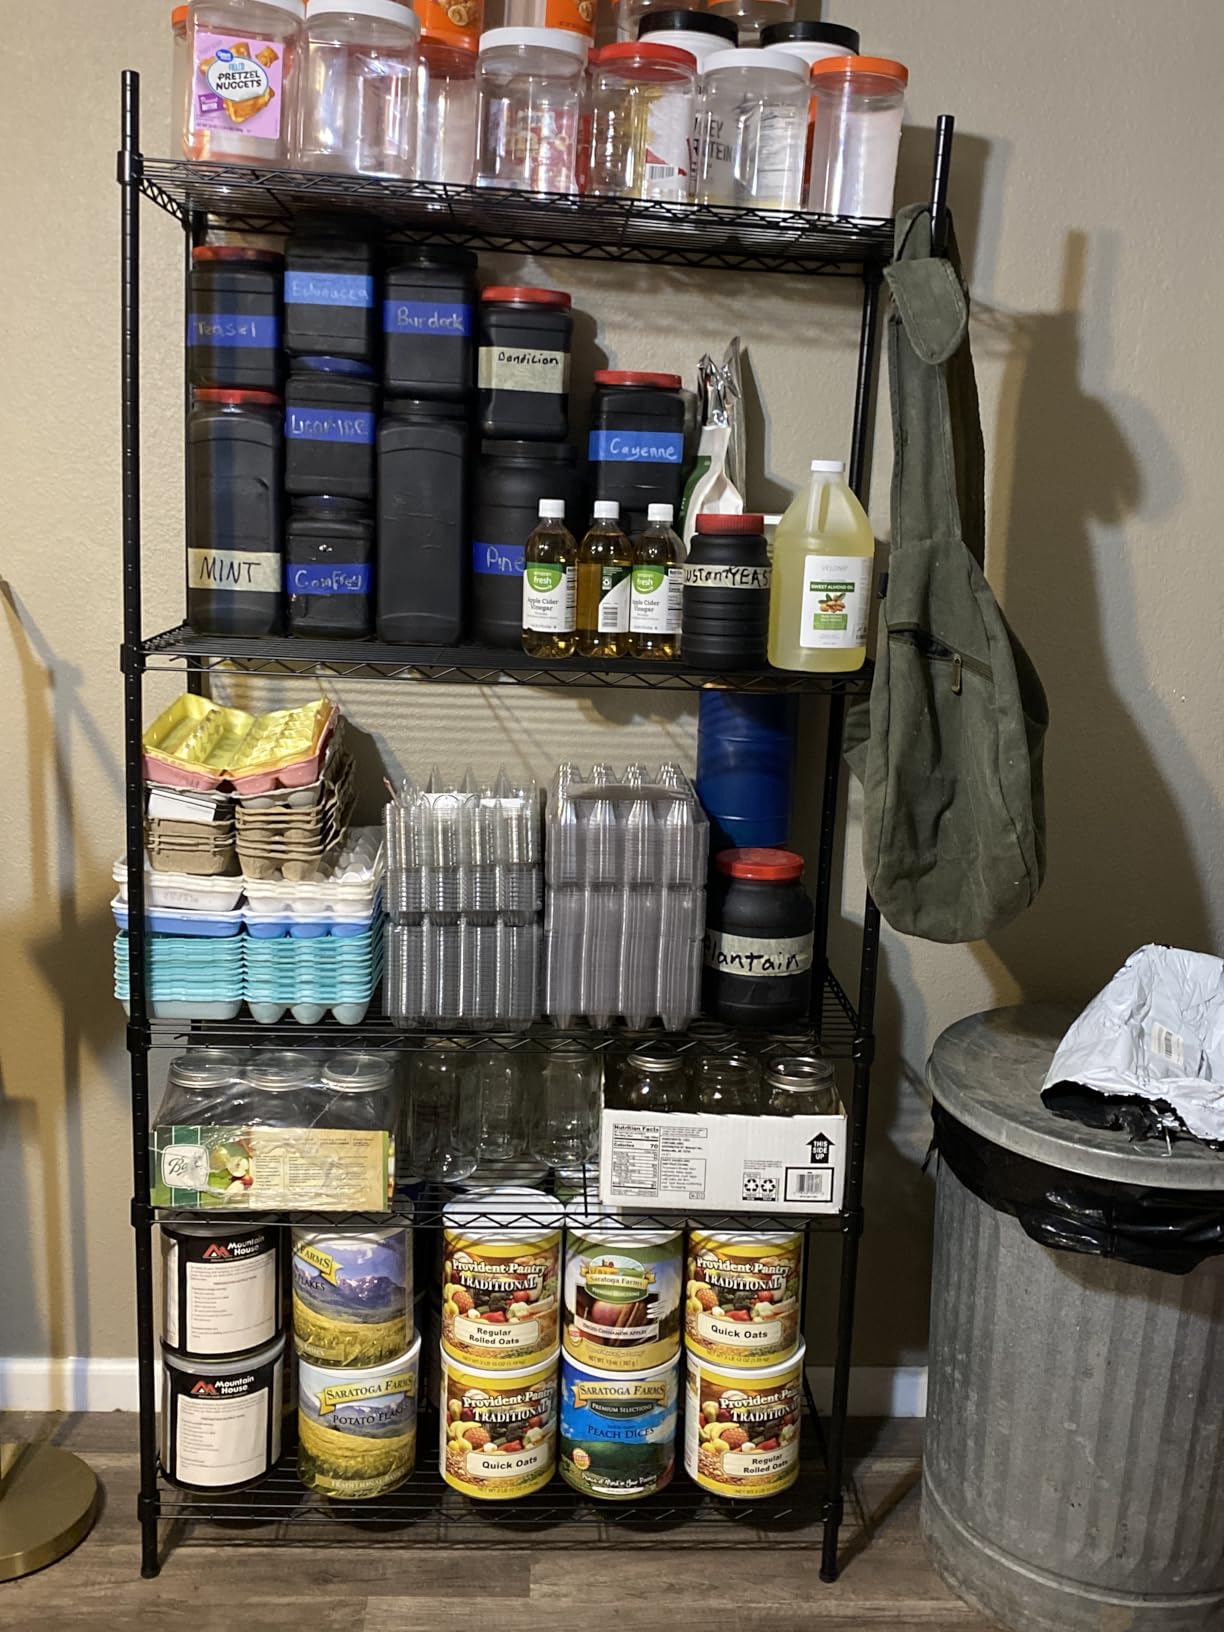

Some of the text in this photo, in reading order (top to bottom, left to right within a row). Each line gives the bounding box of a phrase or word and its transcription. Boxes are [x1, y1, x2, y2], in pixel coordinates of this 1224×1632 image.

[218, 70, 260, 81] PRETZEL
[215, 79, 262, 90] NUGGETS
[396, 306, 465, 332] Burdock
[609, 437, 678, 461] Cayenne
[199, 556, 262, 584] MINT
[533, 575, 552, 585] fresh
[614, 1124, 641, 1132] Nutrition
[227, 1235, 265, 1250] Mountain
[233, 1244, 260, 1256] House
[452, 1258, 547, 1276] Provident Pantry
[696, 1256, 791, 1277] Provident Pantry
[459, 1273, 538, 1292] TRADITIONAL
[703, 1270, 782, 1291] TRADITIONAL
[476, 1327, 512, 1337] Regular
[711, 1324, 768, 1339] Quick Oats
[469, 1334, 496, 1345] Rolled
[214, 1375, 255, 1388] Mountain
[221, 1384, 248, 1394] House
[326, 1384, 382, 1401] SARATOGA
[580, 1384, 666, 1396] SARATOGA FARMS
[462, 1394, 523, 1408] Provident
[591, 1402, 619, 1413] PREMIUM
[719, 1393, 779, 1409] Provident
[472, 1398, 549, 1423] TRADITIONAL
[332, 1414, 375, 1425] POTATO
[587, 1425, 655, 1439] PEACH DICES
[482, 1456, 538, 1470] Quick Oats
[752, 1453, 783, 1466] Regular
[743, 1460, 788, 1474] Rolled Oats
